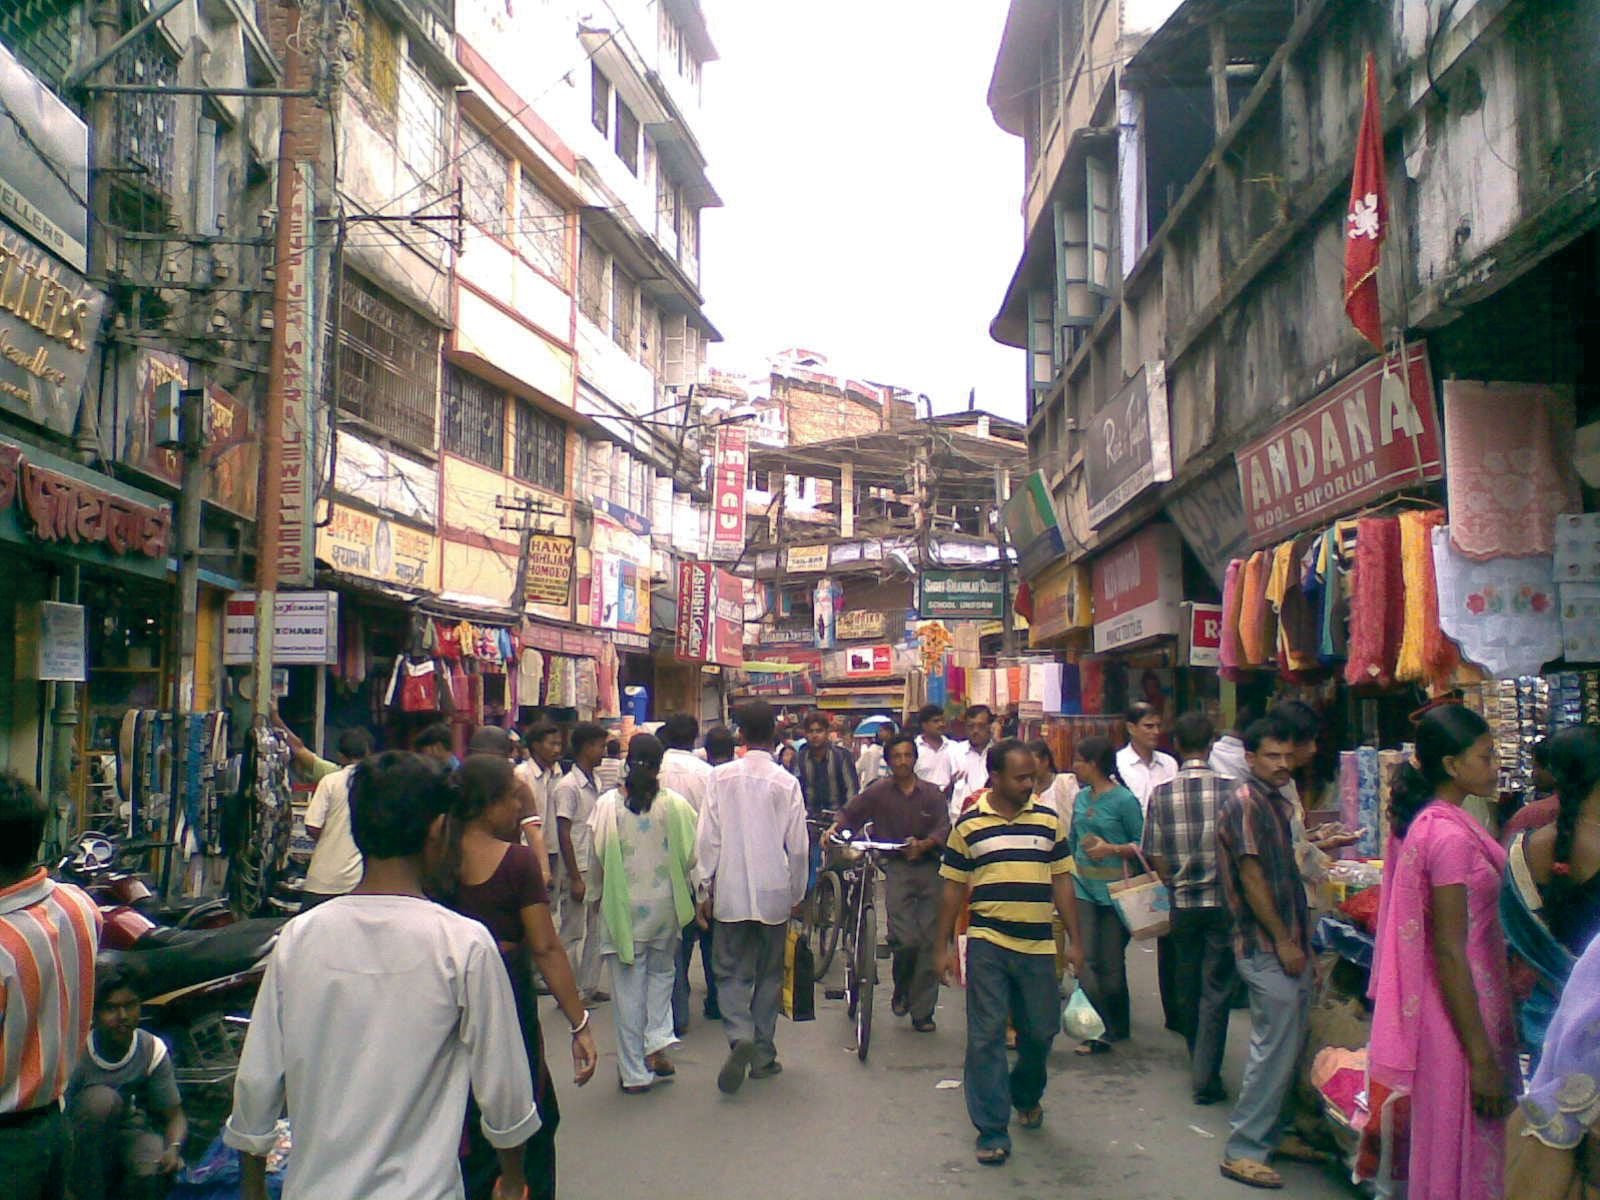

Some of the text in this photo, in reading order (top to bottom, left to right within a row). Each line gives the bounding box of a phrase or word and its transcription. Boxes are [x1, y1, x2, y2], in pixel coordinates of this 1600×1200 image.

[1254, 506, 1291, 530] WOOL
[1294, 461, 1377, 514] EMPORIUM
[691, 565, 706, 615] ASHISH
